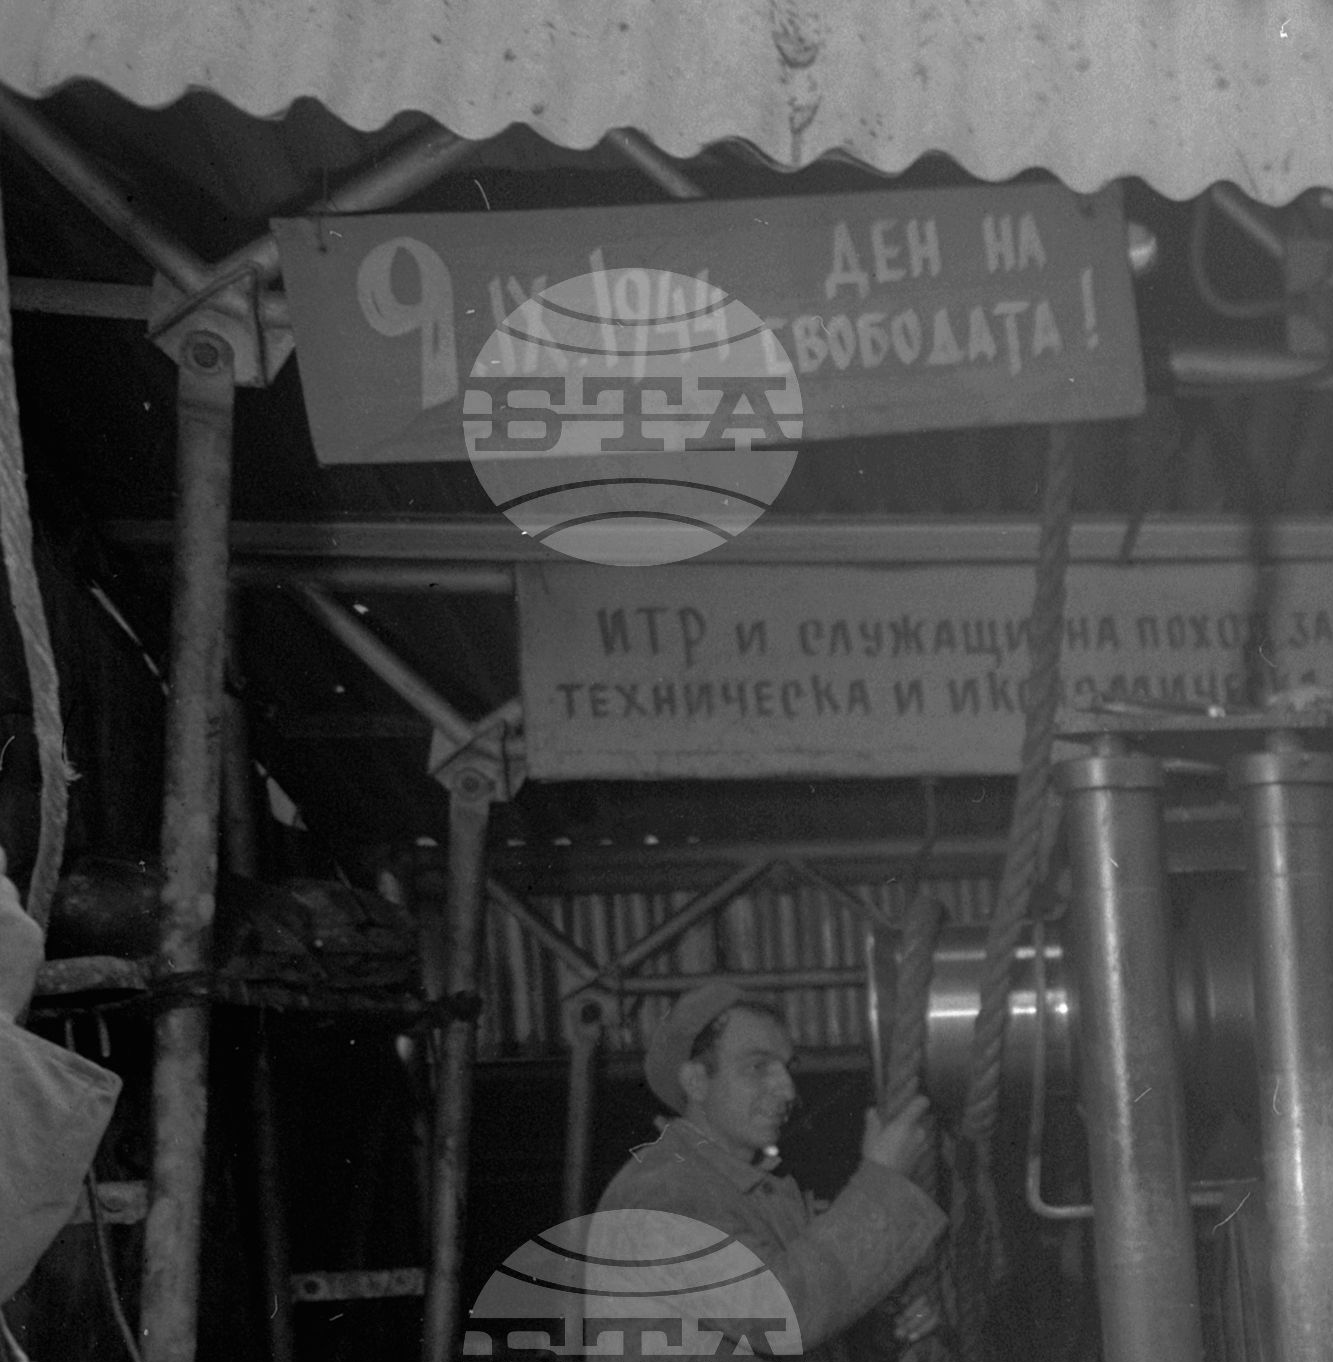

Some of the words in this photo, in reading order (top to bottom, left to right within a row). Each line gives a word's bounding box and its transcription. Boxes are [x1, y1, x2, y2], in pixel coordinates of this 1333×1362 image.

[825, 217, 943, 301] ДЕН
[981, 209, 1049, 275] НА
[596, 606, 707, 667] ИТР
[734, 619, 768, 655] И
[1065, 614, 1120, 652] НА
[1136, 611, 1258, 651] ПОХО
[1288, 609, 1333, 650] ЗА
[554, 674, 873, 722] ТЕХНИЧЕСКА
[892, 678, 926, 717] И
